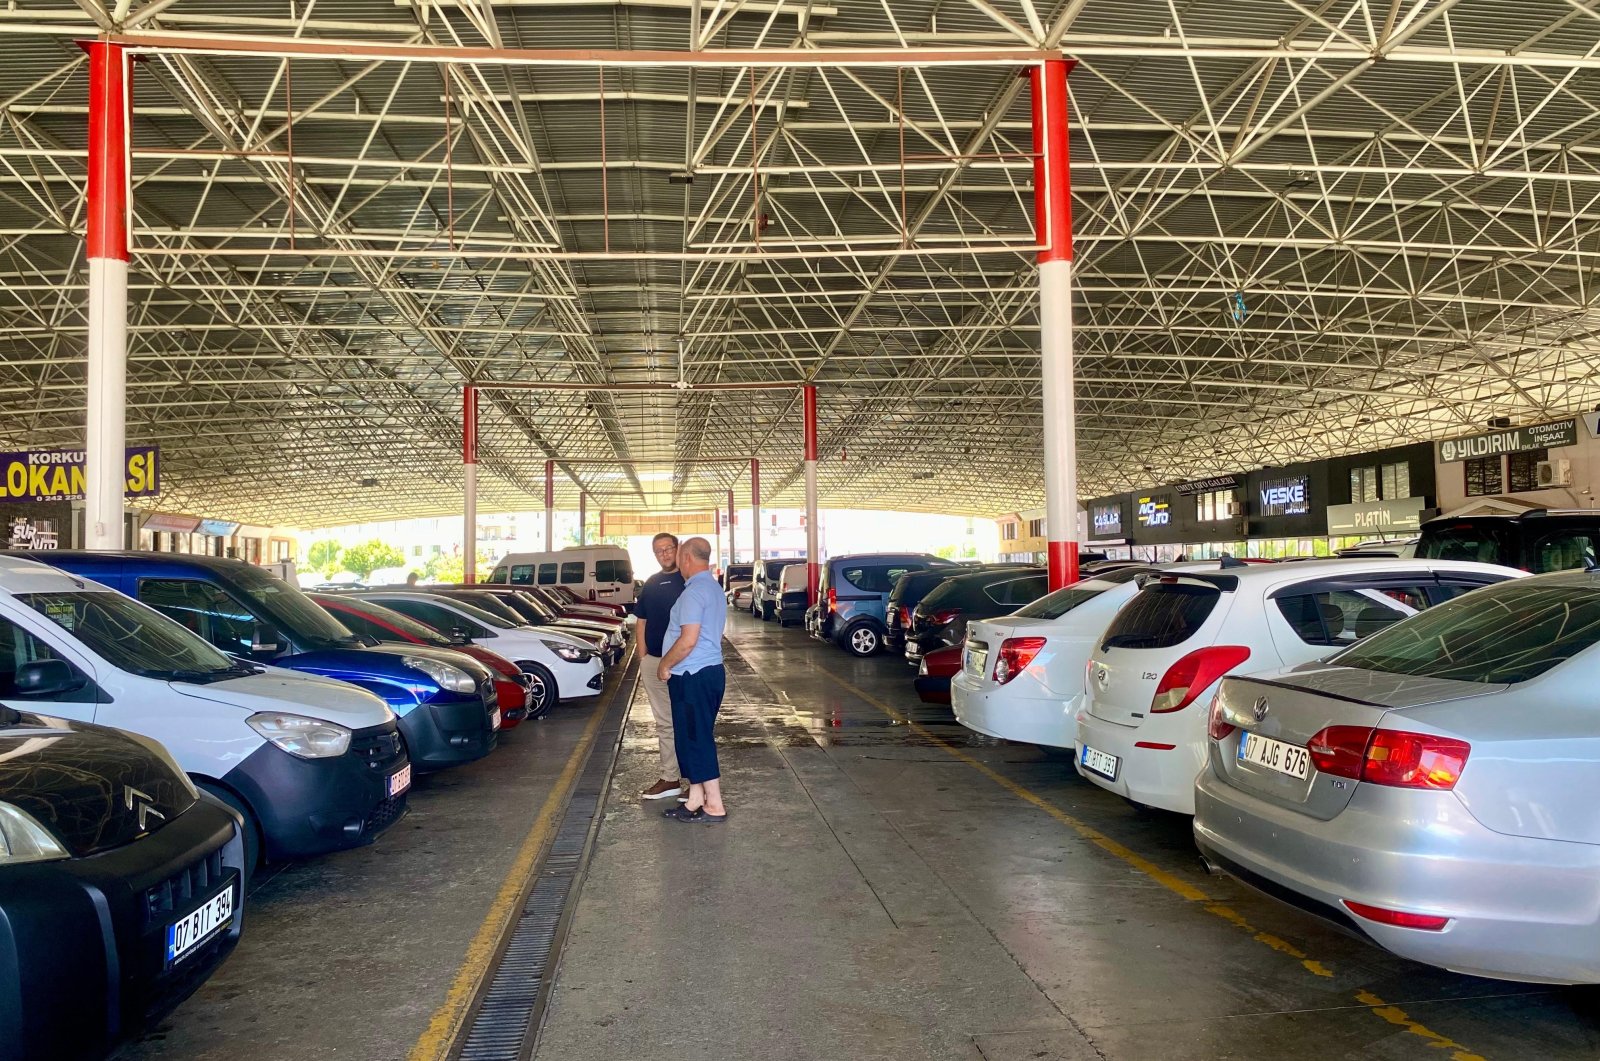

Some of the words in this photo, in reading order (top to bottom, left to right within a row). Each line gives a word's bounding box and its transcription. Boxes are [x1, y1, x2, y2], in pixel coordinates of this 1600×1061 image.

[1528, 421, 1573, 435] OTOMOTİV
[1534, 432, 1565, 443] İNŞAAT
[1457, 432, 1519, 458] YILDIRIM
[1175, 483, 1195, 492] UMUT
[1261, 485, 1304, 505] VESKE
[1354, 507, 1391, 527] PLATİN
[1245, 736, 1258, 759] 07
[1260, 740, 1280, 766] AJG
[1285, 748, 1307, 775] 676
[175, 918, 190, 952] 07
[192, 903, 212, 941] BIT
[215, 889, 231, 923] 394
